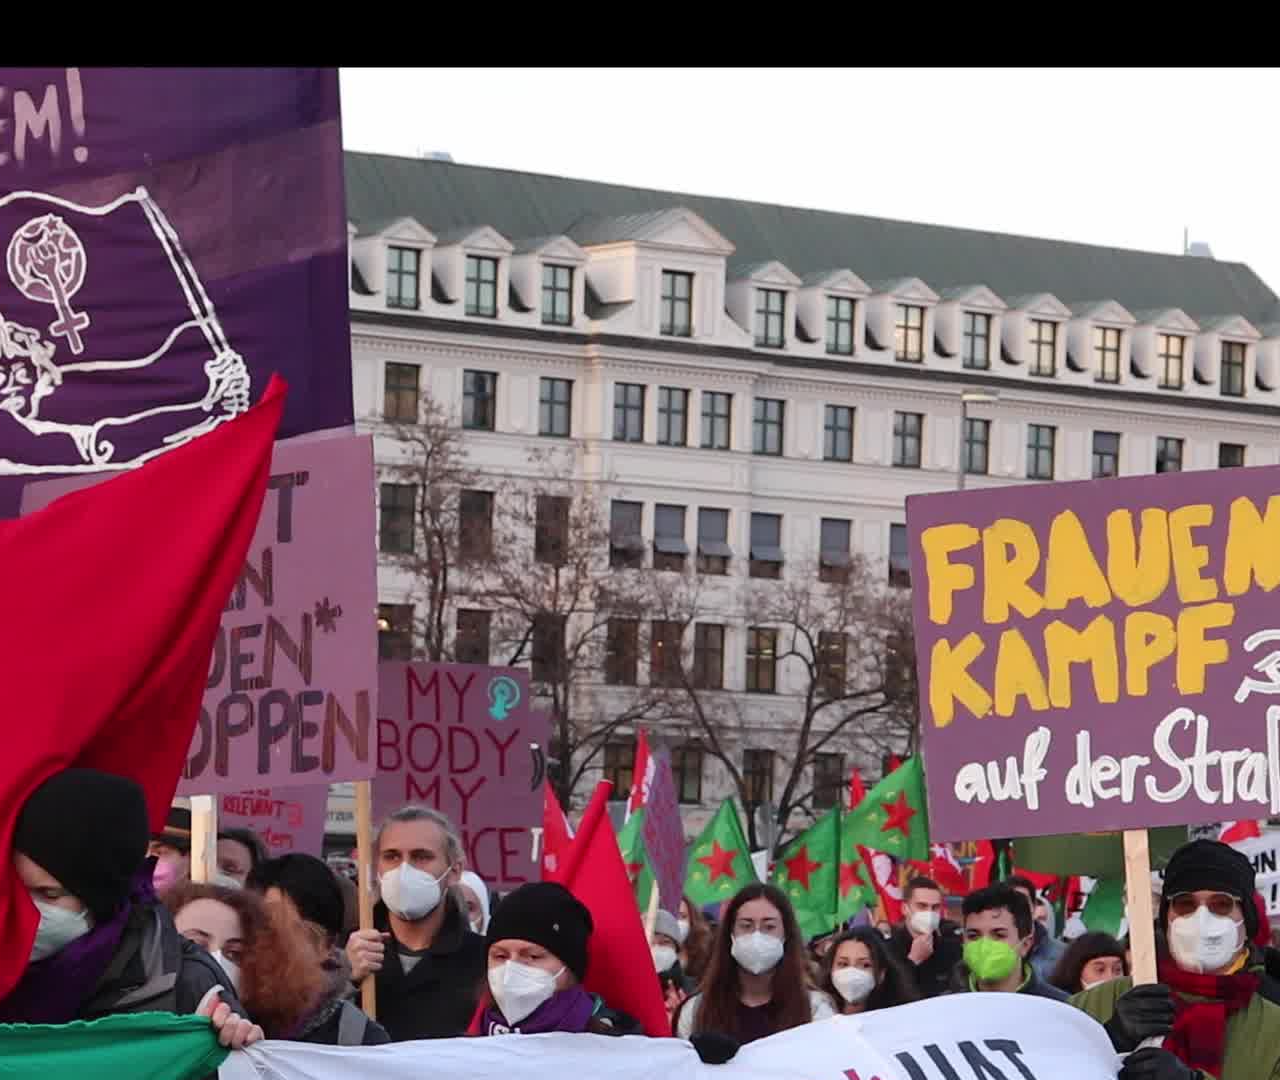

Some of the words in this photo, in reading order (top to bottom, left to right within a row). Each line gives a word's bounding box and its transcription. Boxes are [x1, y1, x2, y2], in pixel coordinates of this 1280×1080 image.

[406, 666, 476, 723] MY
[929, 602, 1236, 728] KAMPF
[377, 718, 519, 777] BODY
[954, 725, 1051, 810] auf
[1066, 729, 1150, 808] der
